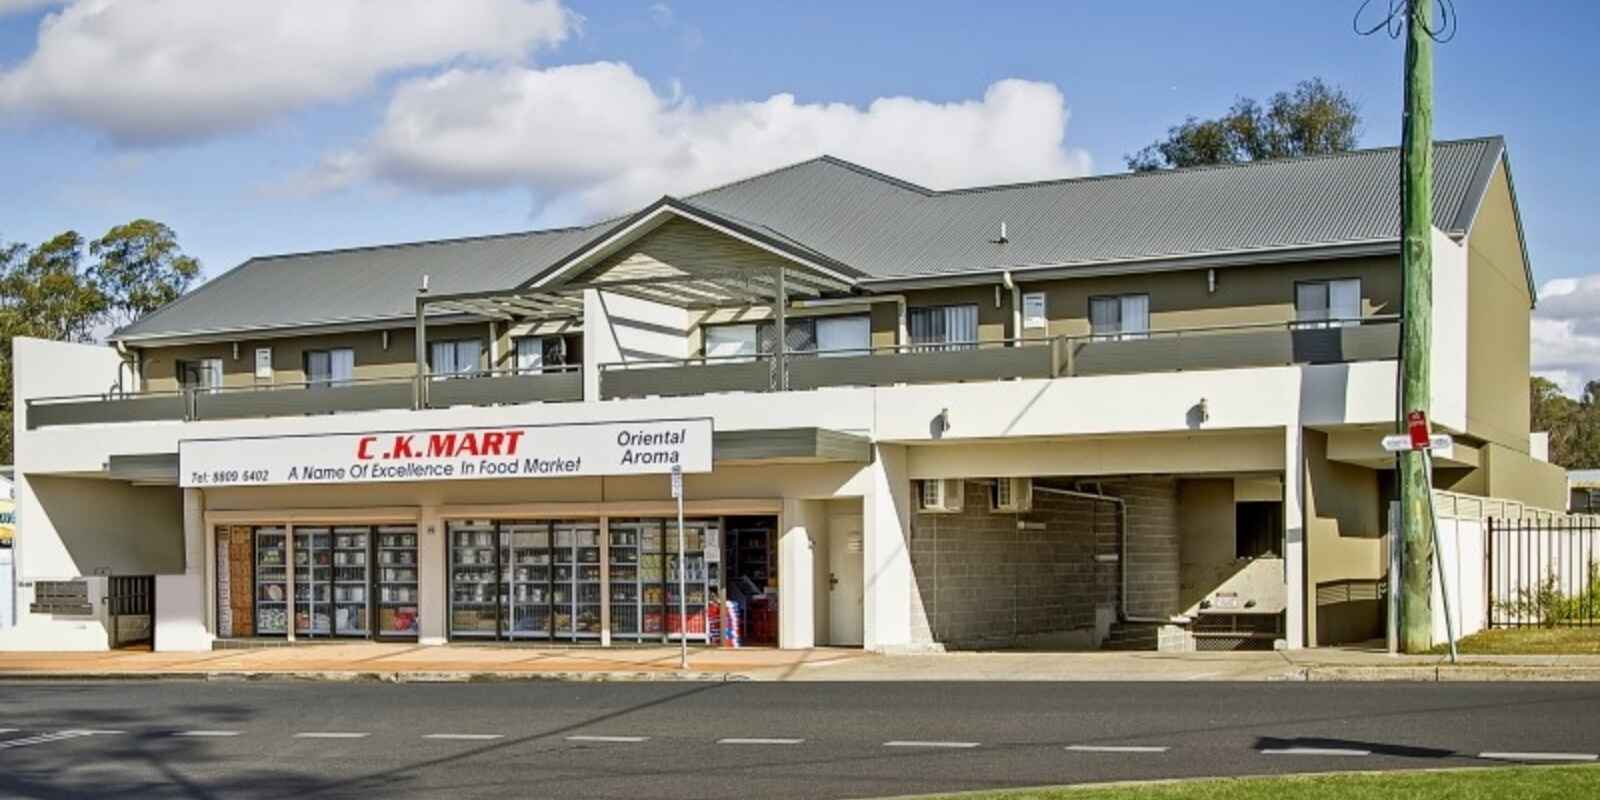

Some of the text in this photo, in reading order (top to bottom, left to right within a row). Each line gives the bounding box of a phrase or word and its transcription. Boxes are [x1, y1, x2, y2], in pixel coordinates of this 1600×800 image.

[617, 429, 686, 447] Oriental
[621, 449, 680, 466] Aroma
[288, 457, 581, 480] A Name Of Excellence In Food Market
